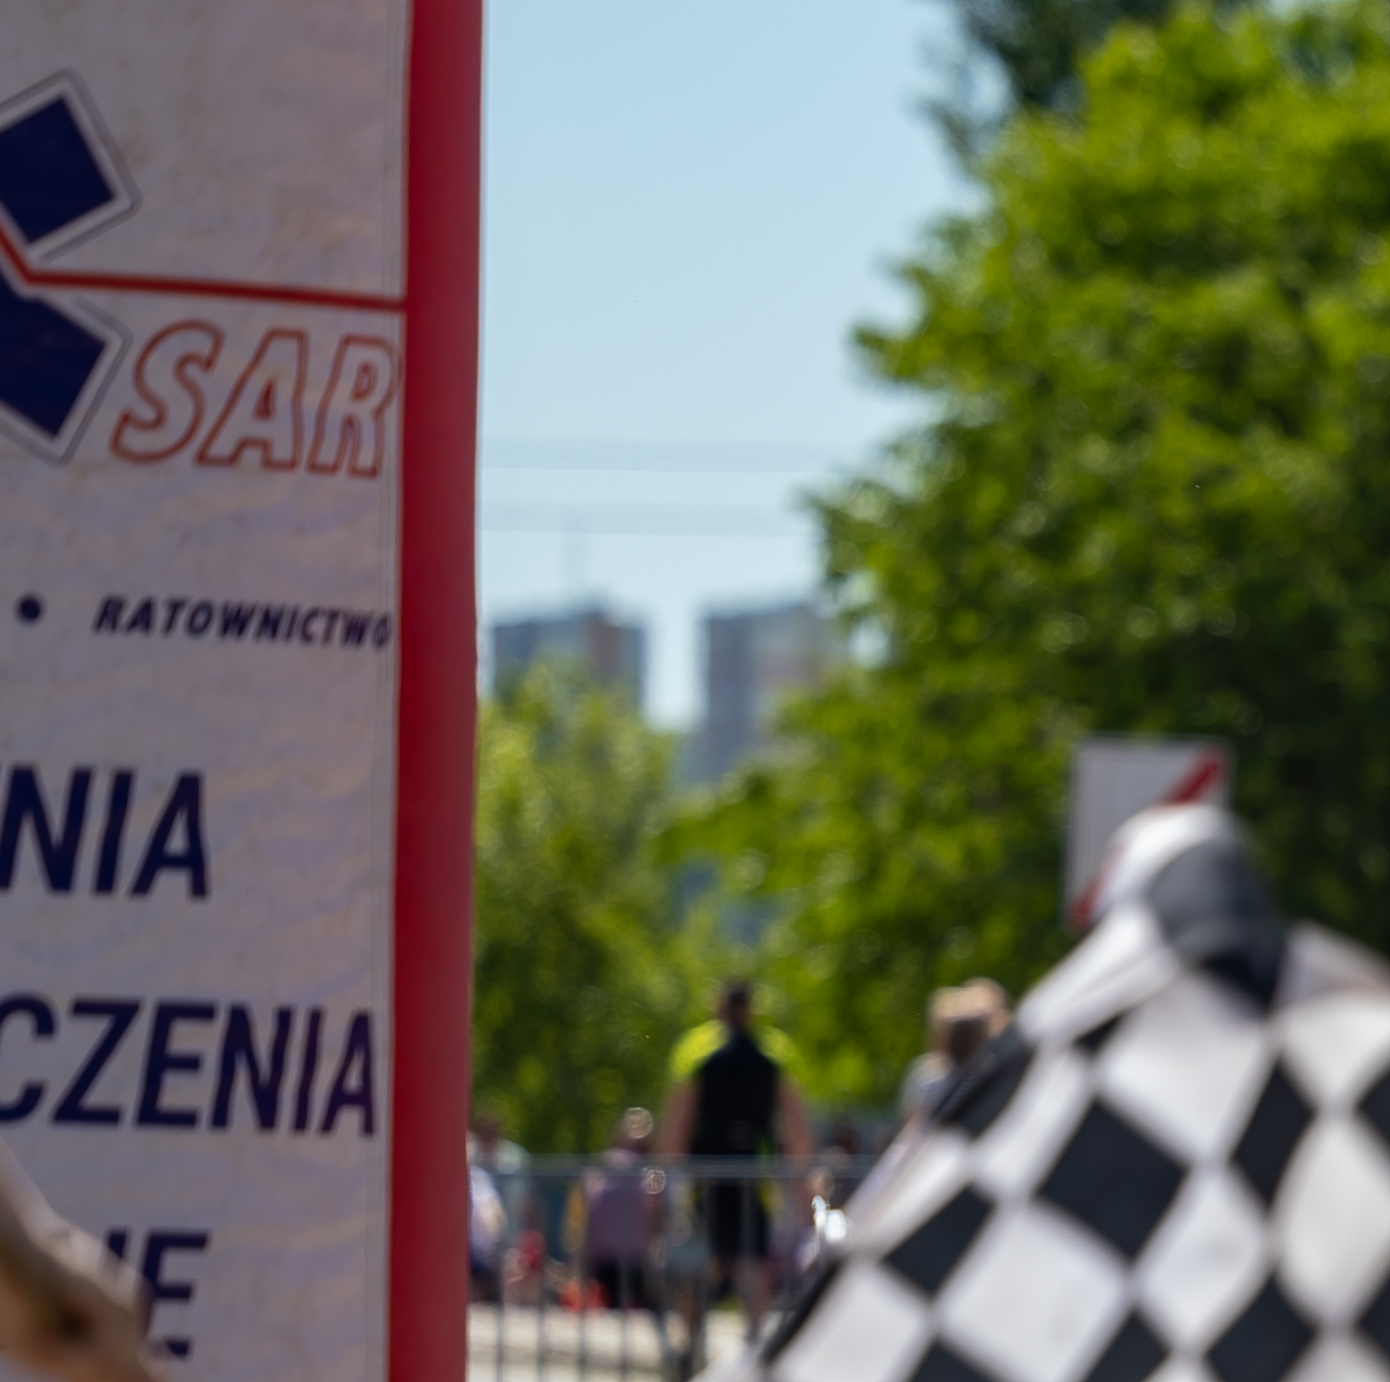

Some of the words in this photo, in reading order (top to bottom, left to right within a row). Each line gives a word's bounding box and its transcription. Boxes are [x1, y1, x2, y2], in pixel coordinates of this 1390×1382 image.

[109, 318, 402, 478] SAR
[92, 595, 392, 651] RATOWNICTWO
[0, 991, 375, 1137] CZENIA
